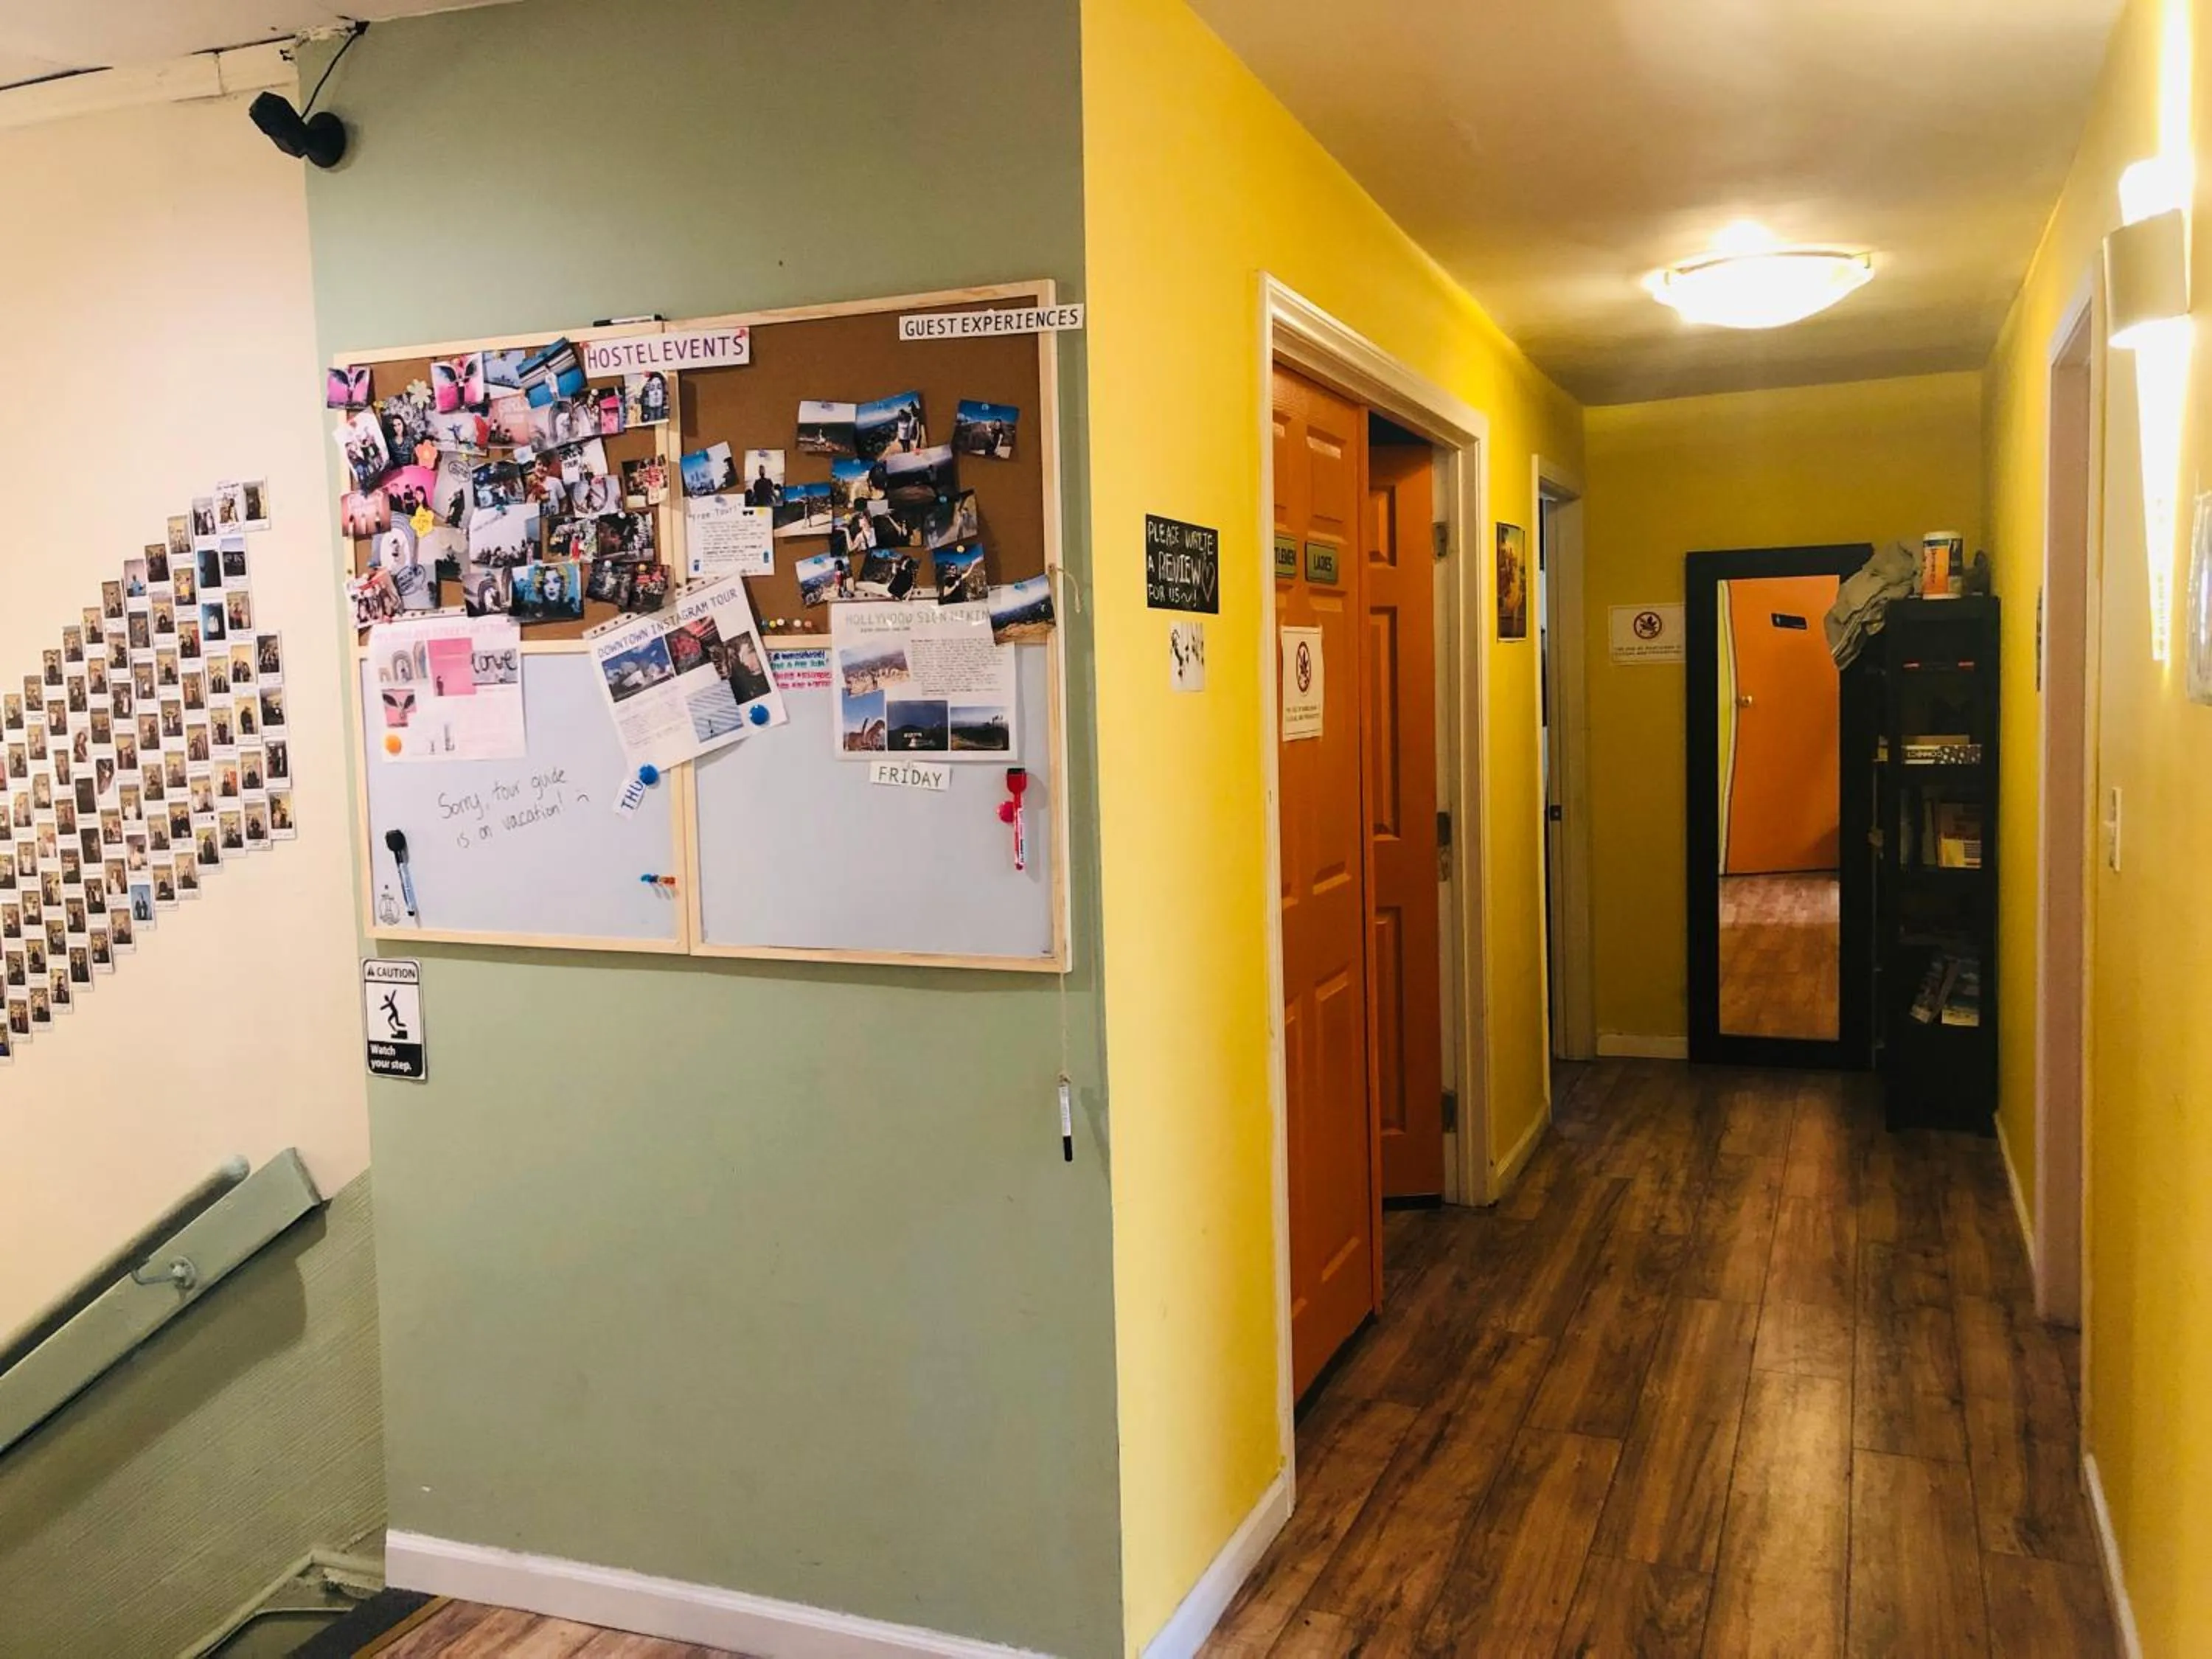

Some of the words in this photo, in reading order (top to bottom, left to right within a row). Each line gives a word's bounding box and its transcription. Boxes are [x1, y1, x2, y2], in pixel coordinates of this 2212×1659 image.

[905, 318, 957, 336] GUEST
[961, 308, 1079, 333] EXPERIENCES
[587, 343, 658, 369] HOSTEL
[663, 335, 745, 361] EVENTS
[1148, 521, 1180, 546] PLEASE
[1184, 529, 1214, 555] WRITE
[1147, 555, 1155, 573] A
[1158, 551, 1202, 585] REVIEW
[1148, 583, 1166, 602] FOR
[597, 628, 650, 658] DOWNTOWN
[652, 601, 709, 635] INSTAGRAM
[709, 588, 738, 608] TOUR
[492, 779, 521, 801] tour
[531, 766, 566, 800] guide
[878, 765, 942, 787] FRIDAY
[456, 832, 470, 849] is
[479, 824, 493, 840] on
[501, 790, 563, 830] vacation!
[377, 967, 415, 978] CAUTION
[369, 1044, 396, 1056] Watch
[370, 1059, 390, 1070] your
